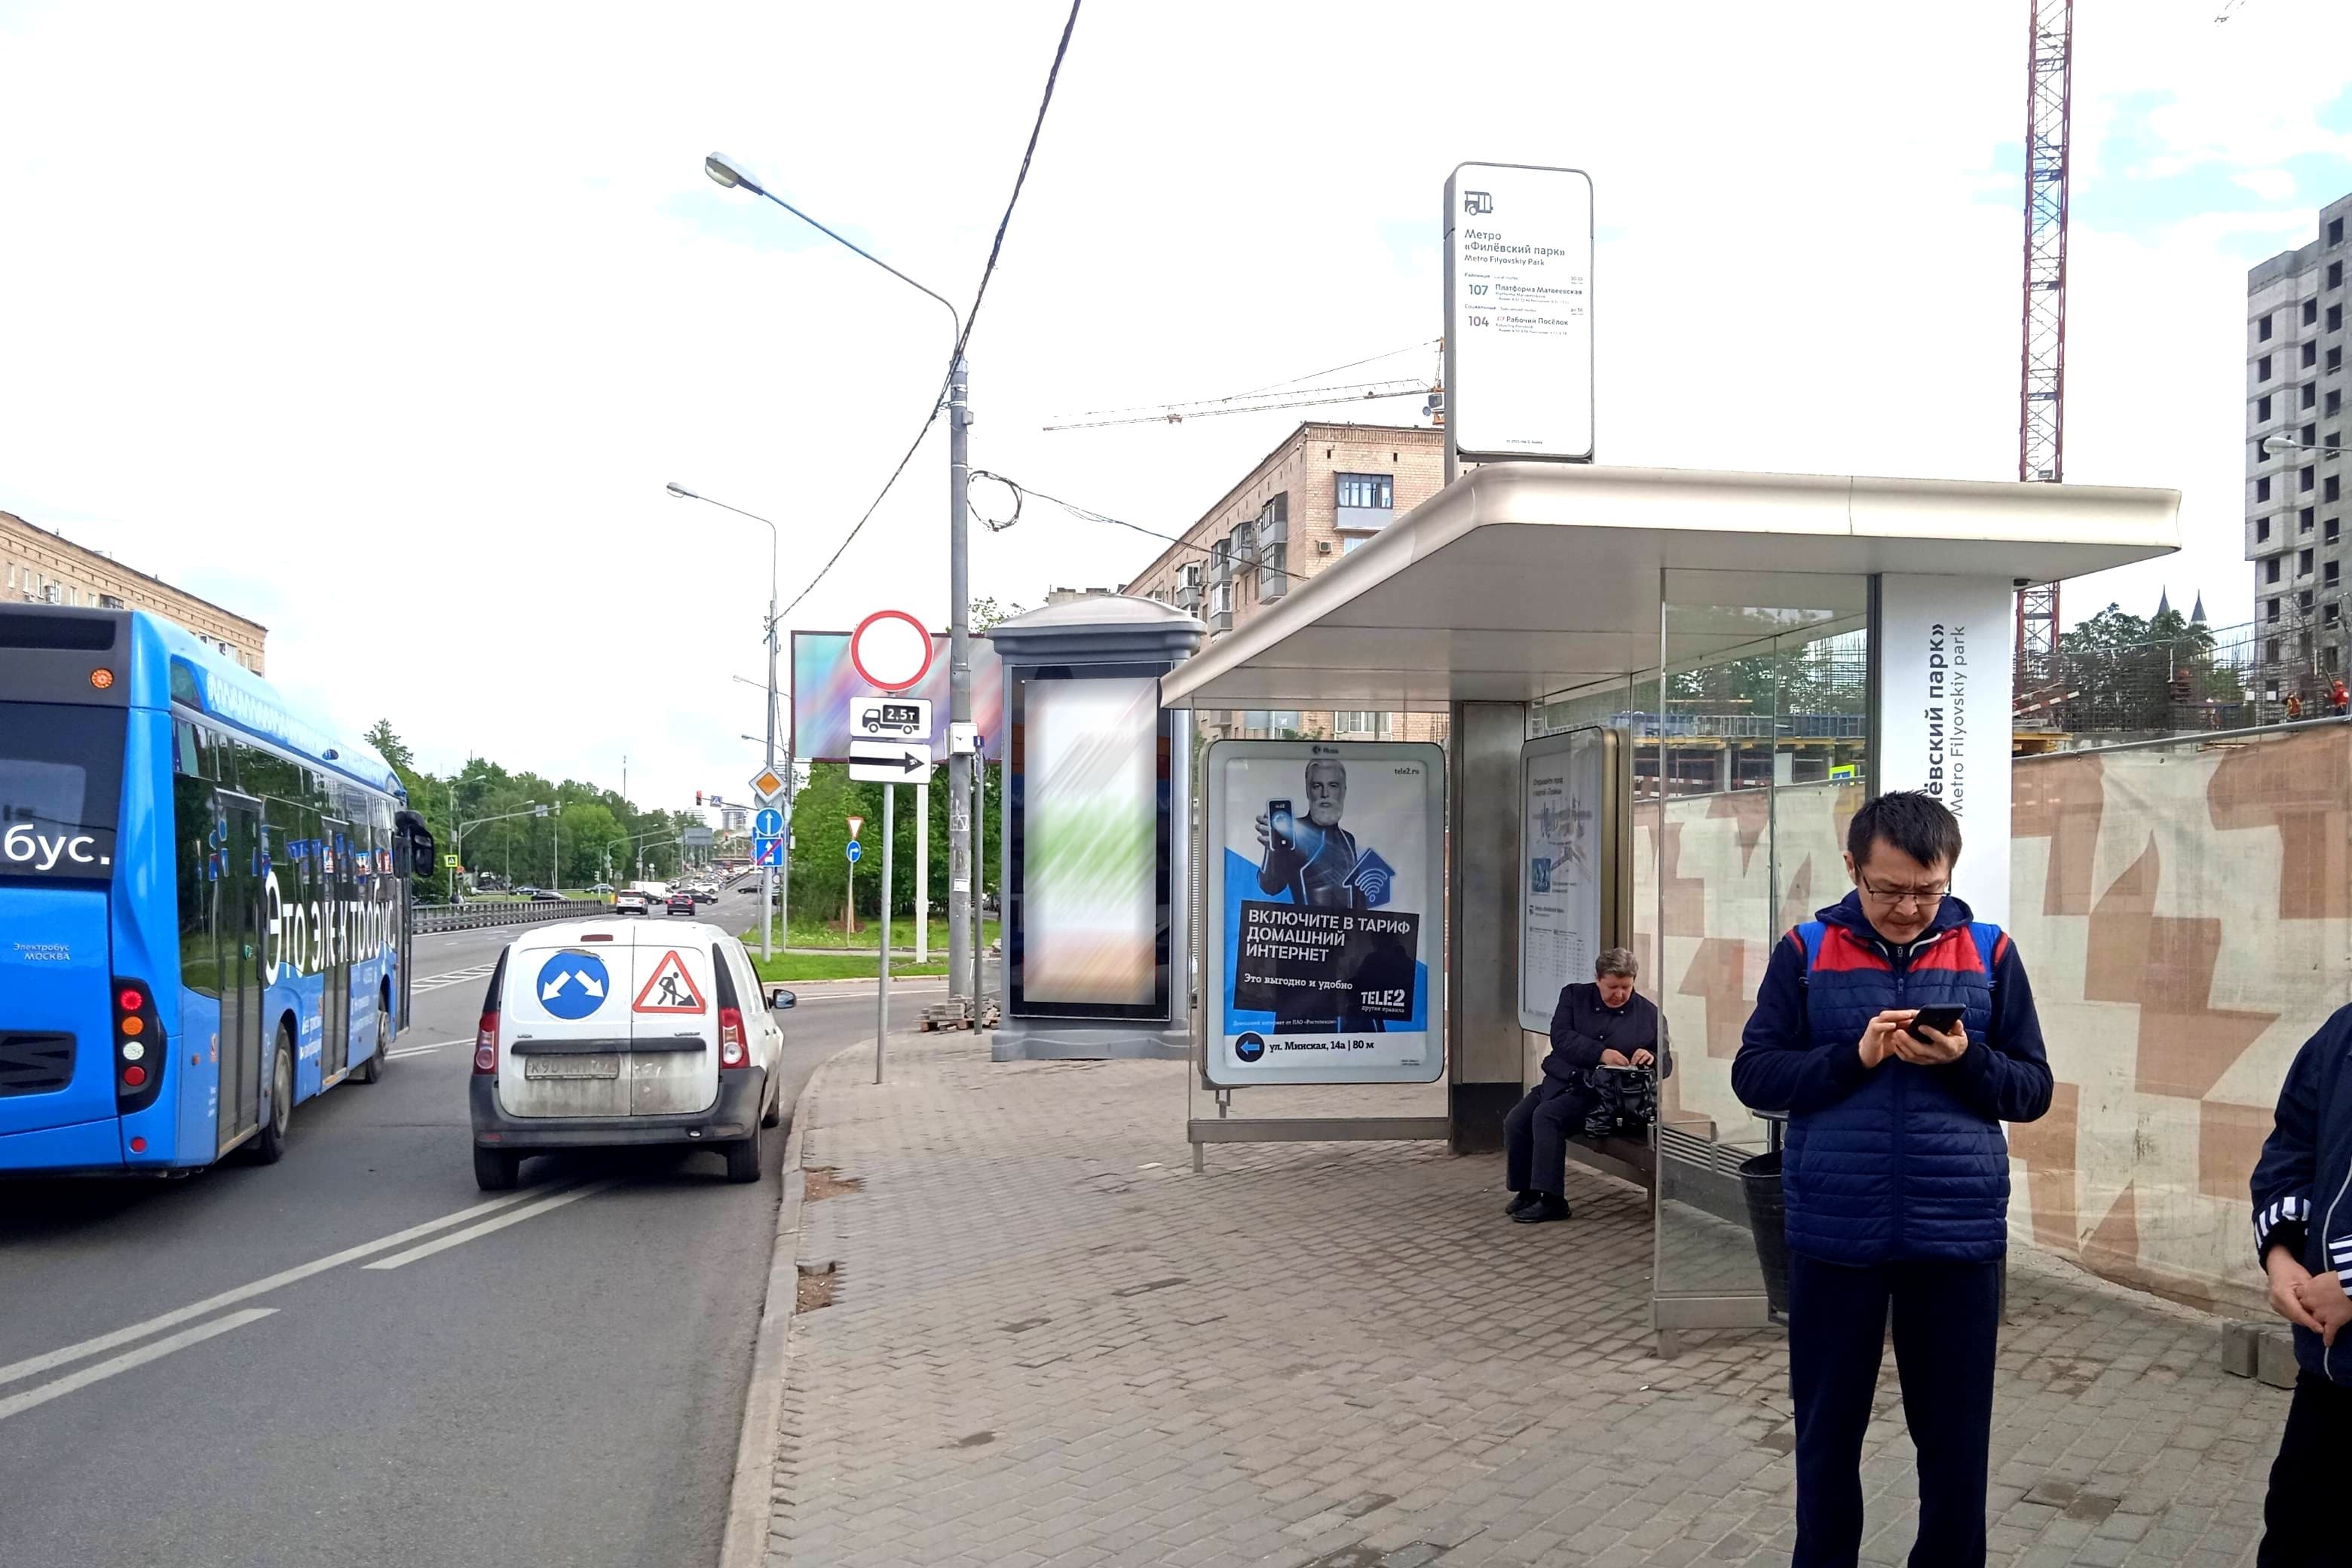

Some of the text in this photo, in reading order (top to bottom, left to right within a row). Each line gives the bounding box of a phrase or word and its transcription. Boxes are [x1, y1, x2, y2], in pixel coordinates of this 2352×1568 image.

[1465, 229, 1502, 241] Метро
[1465, 241, 1565, 257] «Филёвский парк»
[1490, 256, 1527, 266] Filyovskiy
[1468, 284, 1489, 296] 107
[1495, 283, 1536, 294] Платформа
[1468, 316, 1489, 327] 104
[1506, 316, 1569, 326] Рабочий Посёлок
[1929, 623, 1948, 698] парк»
[1949, 626, 1967, 817] Metro Filyovskiy park
[265, 871, 306, 986] Это
[1248, 909, 1410, 935] ВКЛЮЧИТЕ В ТАРИФ
[1247, 926, 1346, 946] ДОМАШНИЙ
[13, 943, 69, 951] Электробус
[1246, 943, 1329, 962] ИНТЕРНЕТ
[24, 952, 71, 960] МОСКВА
[1244, 973, 1262, 984] Это
[1264, 976, 1306, 987] выгодно
[1318, 980, 1353, 991] удобно
[1361, 989, 1405, 1007] TELE2
[1269, 1044, 1282, 1052] ул.
[1285, 1041, 1329, 1052] Минская,
[1331, 1040, 1346, 1049] 14а
[1352, 1040, 1364, 1049] 80
